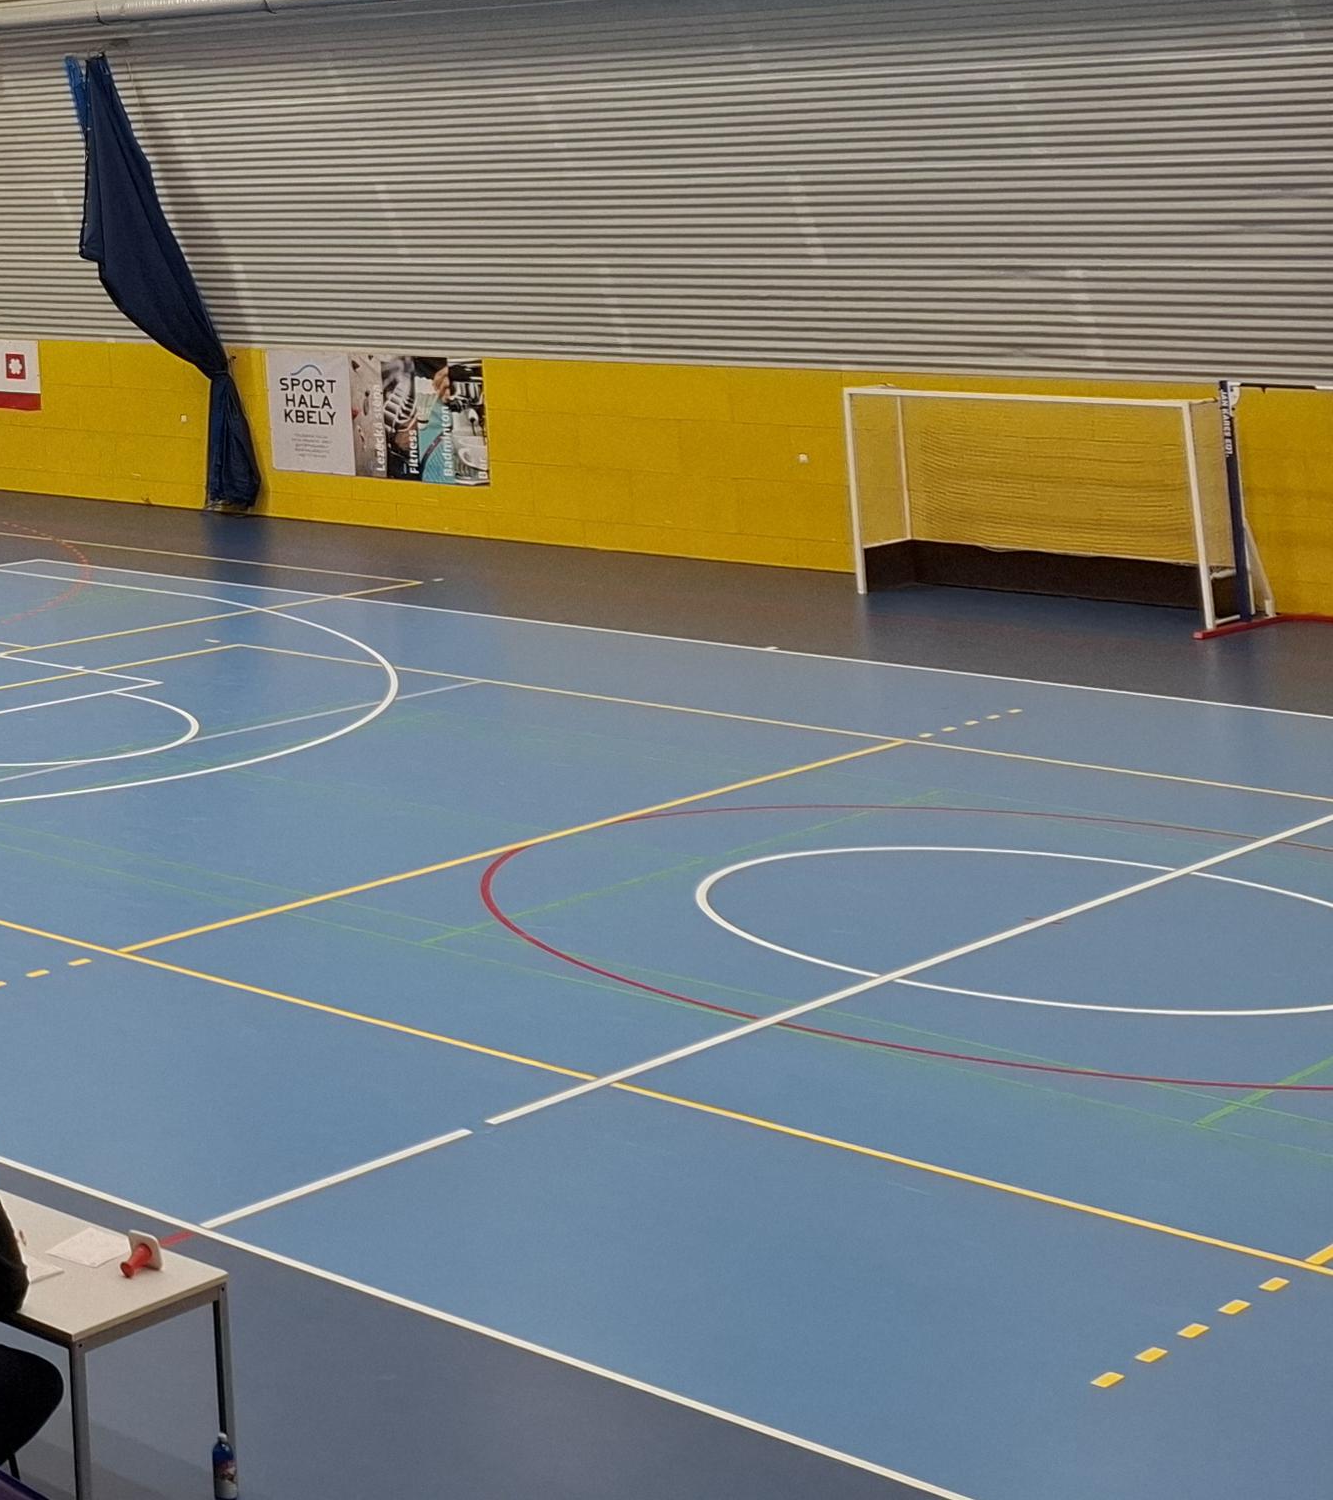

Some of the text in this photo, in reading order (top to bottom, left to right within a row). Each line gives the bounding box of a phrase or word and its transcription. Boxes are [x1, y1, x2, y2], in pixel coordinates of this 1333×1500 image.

[279, 377, 336, 393] SPORT
[285, 393, 332, 409] HALA
[284, 408, 336, 425] KBELY
[442, 406, 453, 477] Badminton
[409, 429, 420, 474] Fitness
